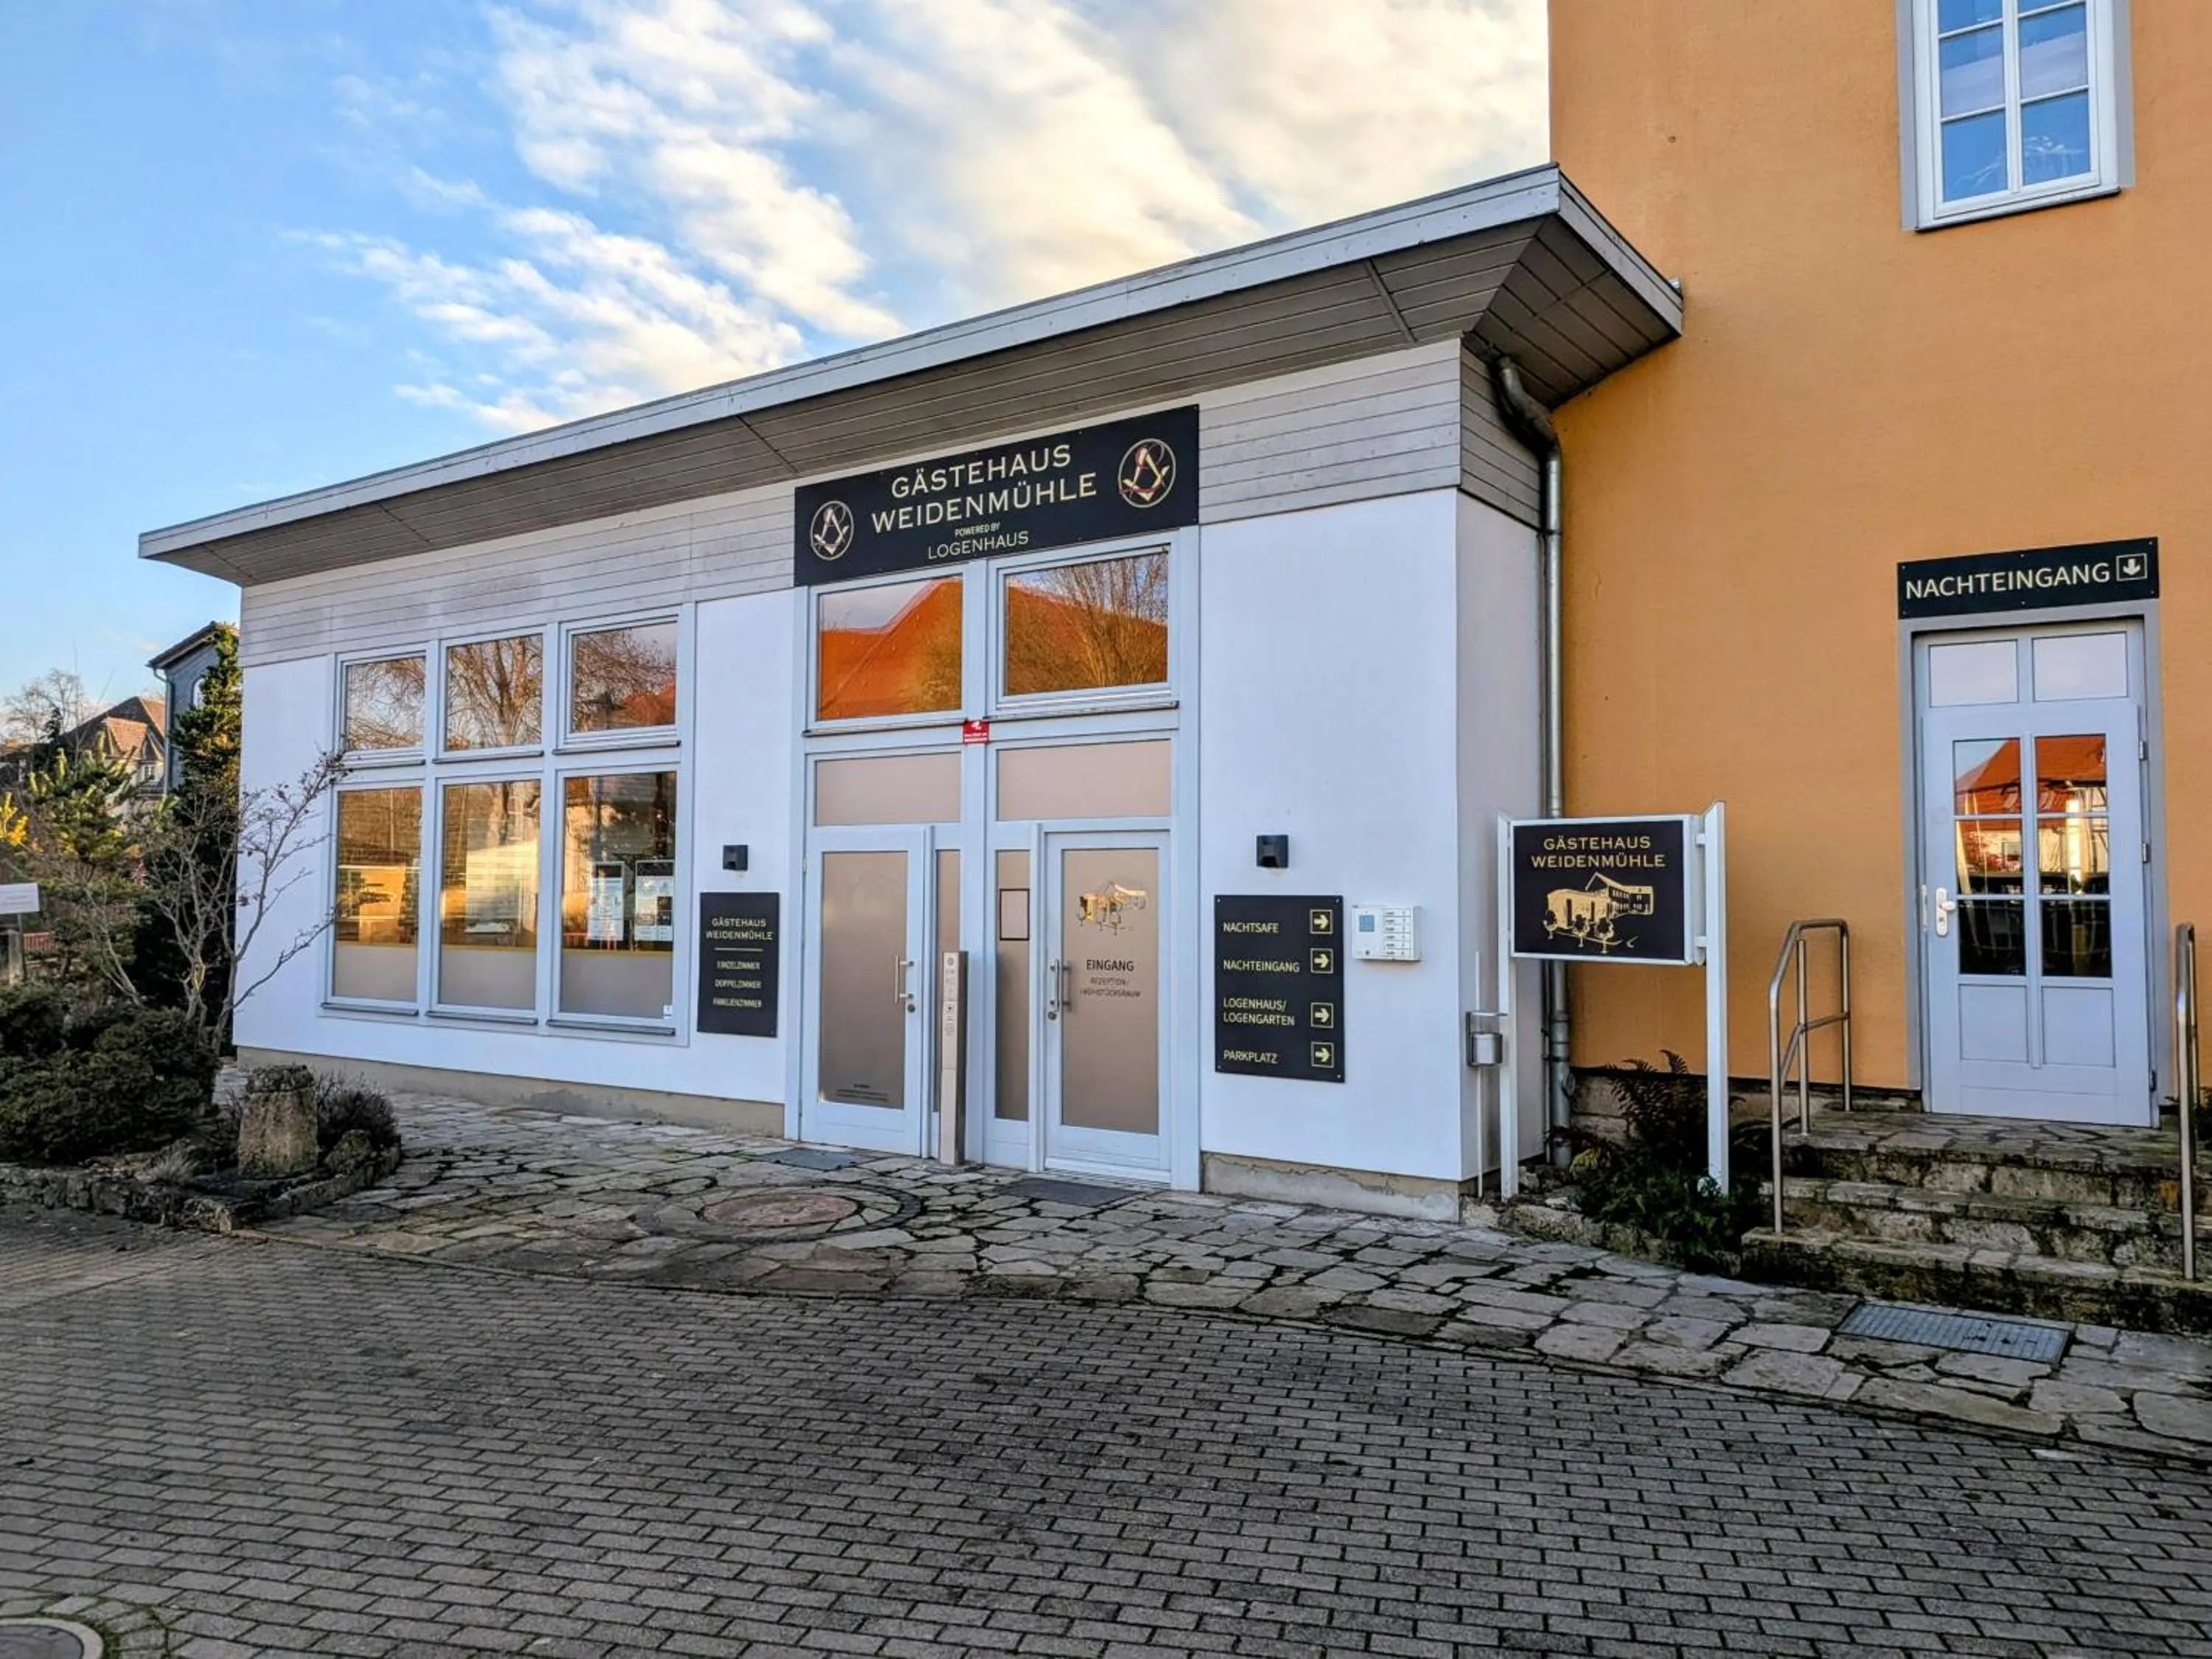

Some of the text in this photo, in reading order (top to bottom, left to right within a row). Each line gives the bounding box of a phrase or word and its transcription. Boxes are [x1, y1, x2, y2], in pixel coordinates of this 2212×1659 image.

[891, 444, 1071, 498] GÄSTEHAUS
[872, 473, 1097, 534] WEIDENMÜHLE
[955, 522, 1001, 538] POWERED BY
[928, 531, 1029, 560] LOGENHAUS
[1905, 563, 2111, 599] NACHTEINGANG
[1543, 835, 1651, 850] GÄSTEHAUS
[1531, 852, 1666, 869] WEIDENMÜHLE
[712, 917, 767, 928] GÄSTEHAUS
[1223, 922, 1279, 933] NACHTSAFE
[706, 929, 773, 940] WEIDENMÜHLE
[1086, 959, 1134, 972] EINGANG
[1223, 960, 1300, 973] NACHTEINGANG
[1223, 997, 1287, 1012] LOGENHAUS/
[1223, 1012, 1295, 1026] LOGENGARTEN
[1223, 1050, 1278, 1064] PARKPLATZ
